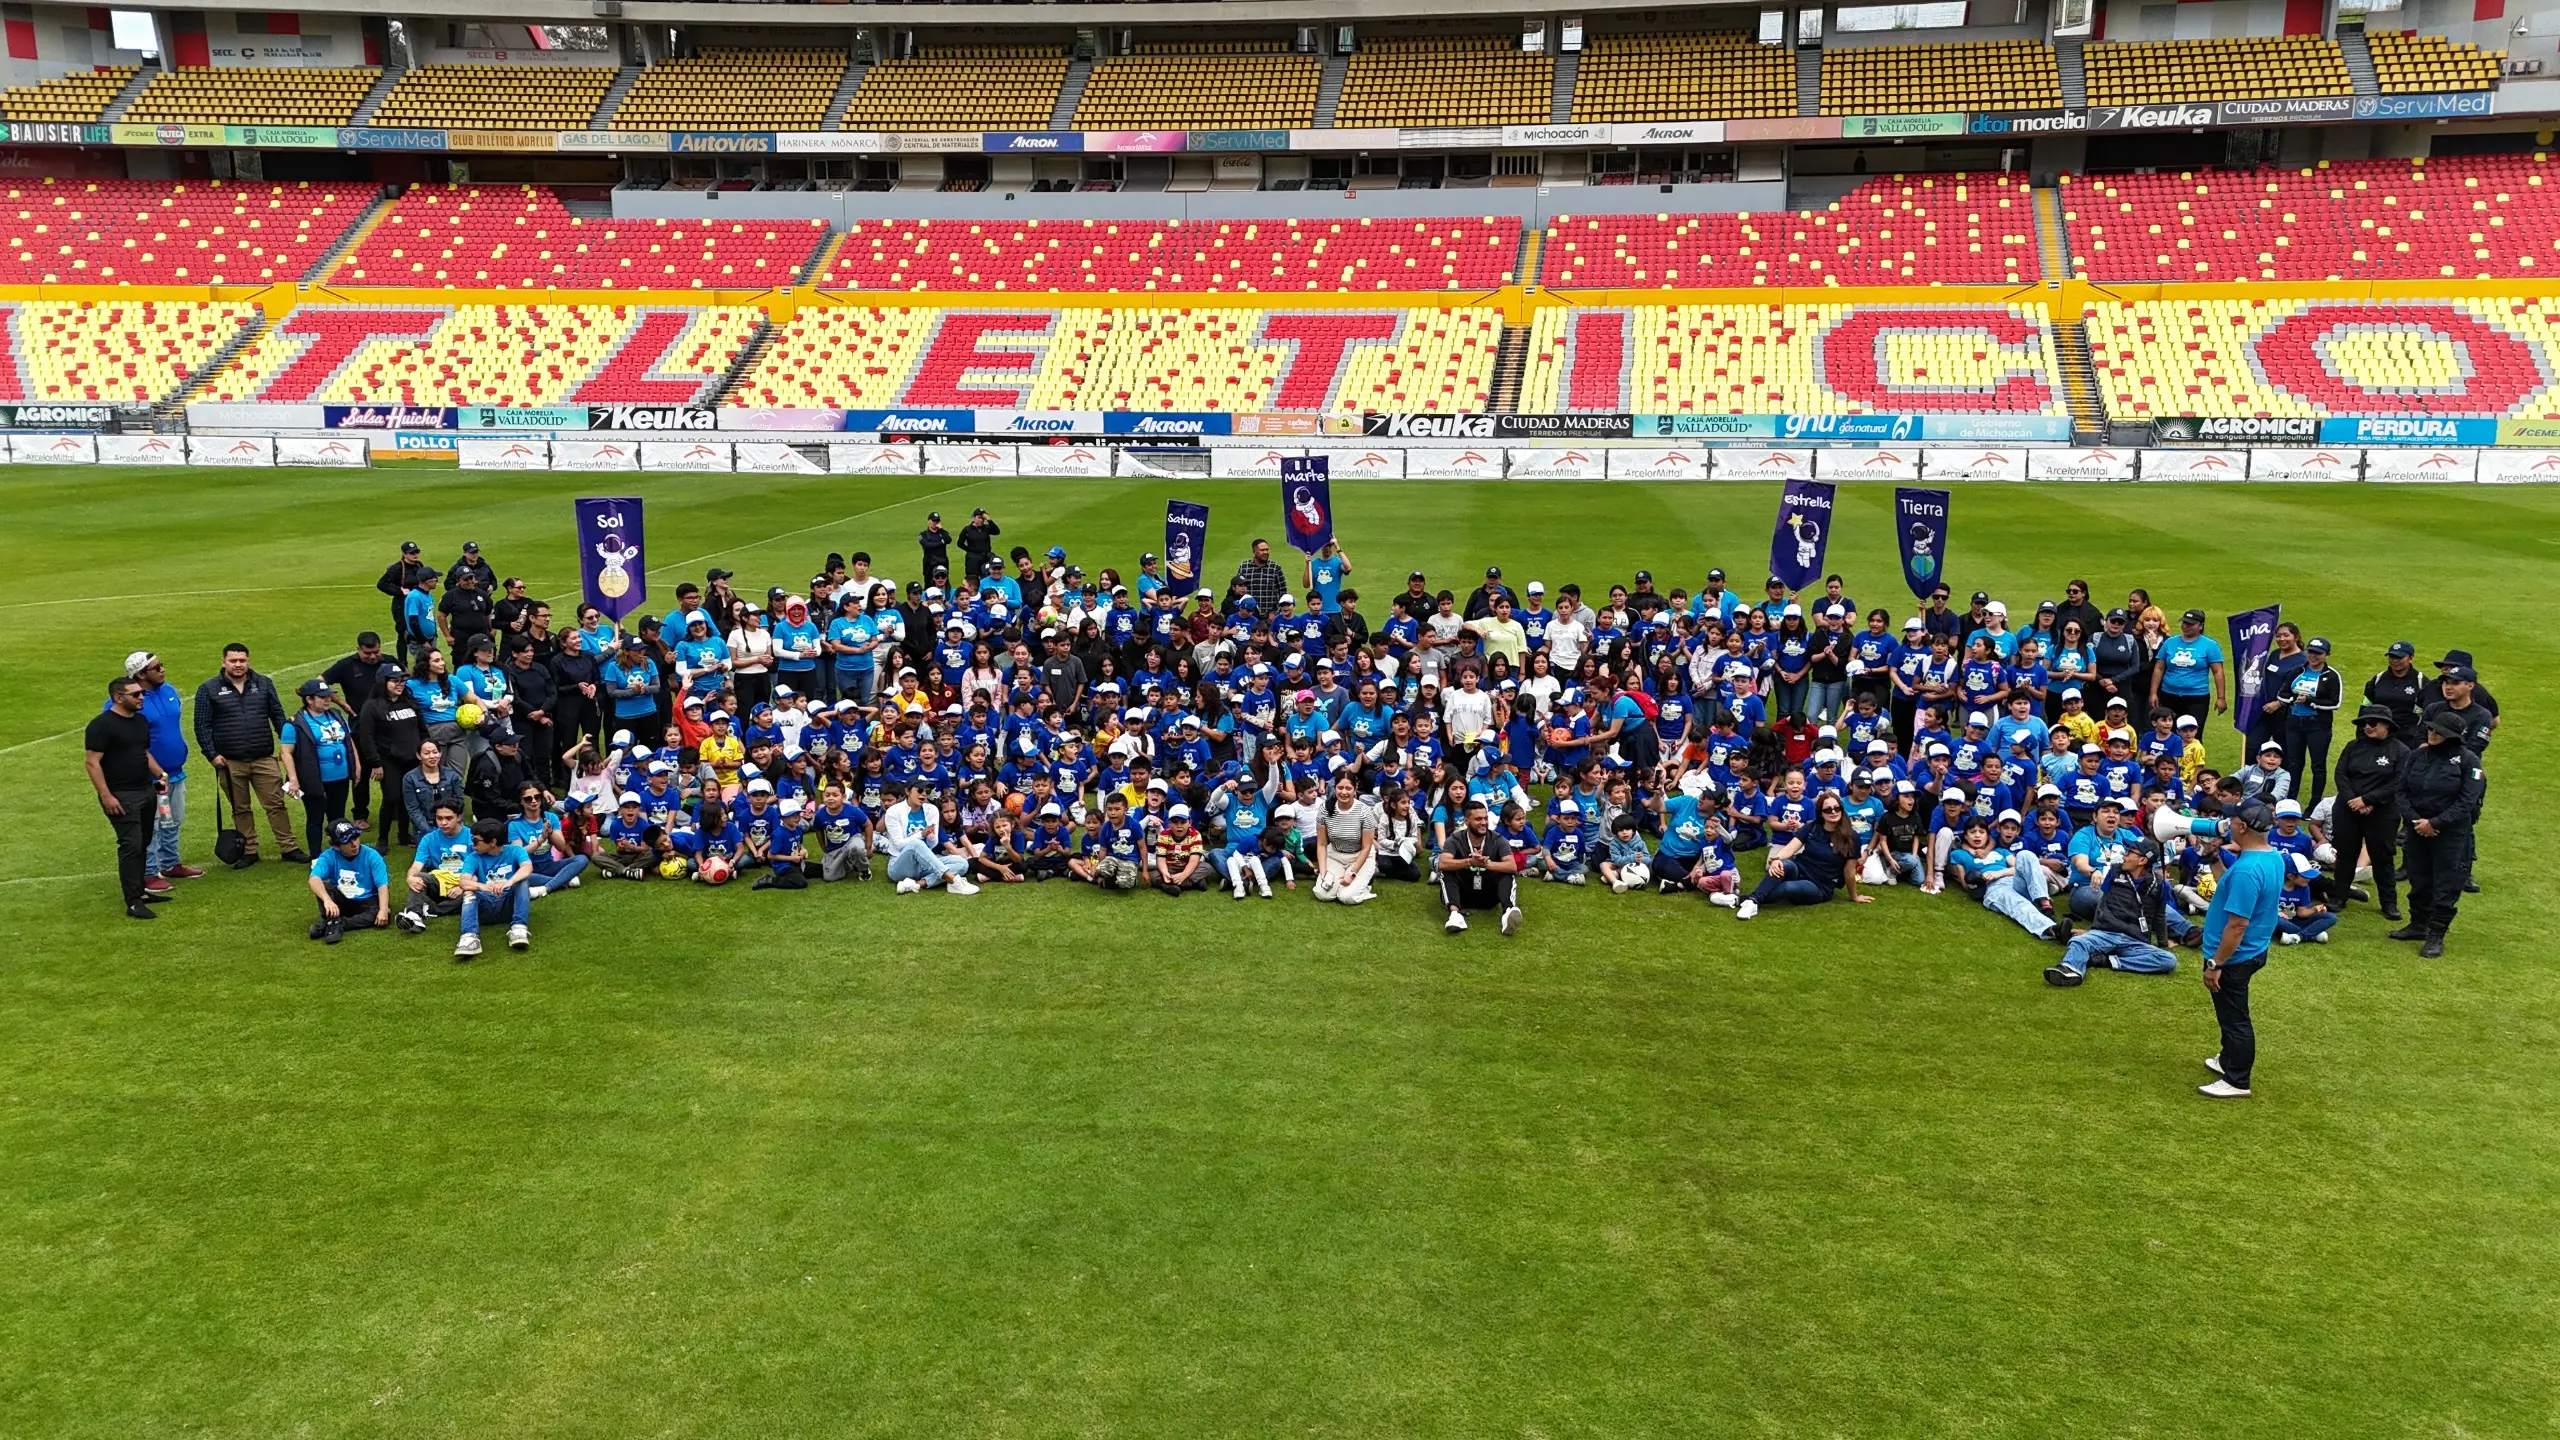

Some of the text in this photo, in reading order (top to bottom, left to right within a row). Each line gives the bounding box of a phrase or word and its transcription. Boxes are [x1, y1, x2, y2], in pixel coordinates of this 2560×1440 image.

[241, 48, 255, 57] C
[2225, 99, 2349, 115] CIUDAD MADERAS
[2012, 110, 2086, 131] morelia
[2120, 106, 2212, 128] Keuka
[11, 123, 109, 142] BAUSER LIFE
[188, 130, 214, 139] EXTRA
[1524, 126, 1589, 140] Michoacán
[1641, 128, 1694, 139] AKRON
[453, 133, 553, 147] CLUB ATLÉTICO MORELIA
[563, 134, 650, 145] GAS DEL LAGO
[678, 133, 769, 151] Autovías
[779, 139, 825, 147] HARINERA
[1009, 136, 1057, 147] AKRON
[0, 150, 29, 168] ola
[338, 406, 443, 428] Salsa Huichol
[612, 407, 716, 430] Keuka
[1502, 416, 1629, 429] CIUDAD MADERAS
[876, 415, 946, 431] AKRON
[1005, 416, 1074, 431] AKRON
[1133, 417, 1203, 432] AKRON
[1388, 413, 1495, 437] Keuka
[1785, 414, 1834, 437] gnu
[1972, 418, 2022, 428] Gobierno
[2199, 419, 2314, 434] AGROMICH
[2358, 420, 2457, 436] PERDURA
[1960, 426, 2033, 437] de Michoacán
[400, 436, 451, 449] POLLO
[26, 453, 75, 462] ArcelorMittal
[114, 454, 164, 463] ArcelorMittal
[204, 456, 254, 465] ArcelorMittal
[475, 460, 527, 469] ArcelorMittal
[567, 460, 618, 469] ArcelorMittal
[657, 461, 710, 470] ArcelorMittal
[846, 465, 898, 474] ArcelorMittal
[941, 465, 994, 473] ArcelorMittal
[1035, 465, 1088, 474] ArcelorMittal
[1227, 468, 1281, 477] ArcelorMitta
[1284, 471, 1325, 482] Marte
[1423, 468, 1479, 477] ArcelorMittal
[1524, 468, 1581, 477] ArcelorMittal
[1625, 469, 1683, 478] ArcelorMittal
[1728, 469, 1787, 478] ArcelorMittal
[1833, 469, 1892, 478] ArcelorMittal
[2046, 467, 2108, 476] ArcelorMittal
[2384, 472, 2448, 481] ArcelorMittal
[2157, 473, 2219, 482] ArcelorMittal
[1785, 494, 1831, 509] Estrella
[1900, 499, 1943, 517] Tierra
[597, 513, 624, 529] Sol
[2239, 622, 2271, 641] Luna
